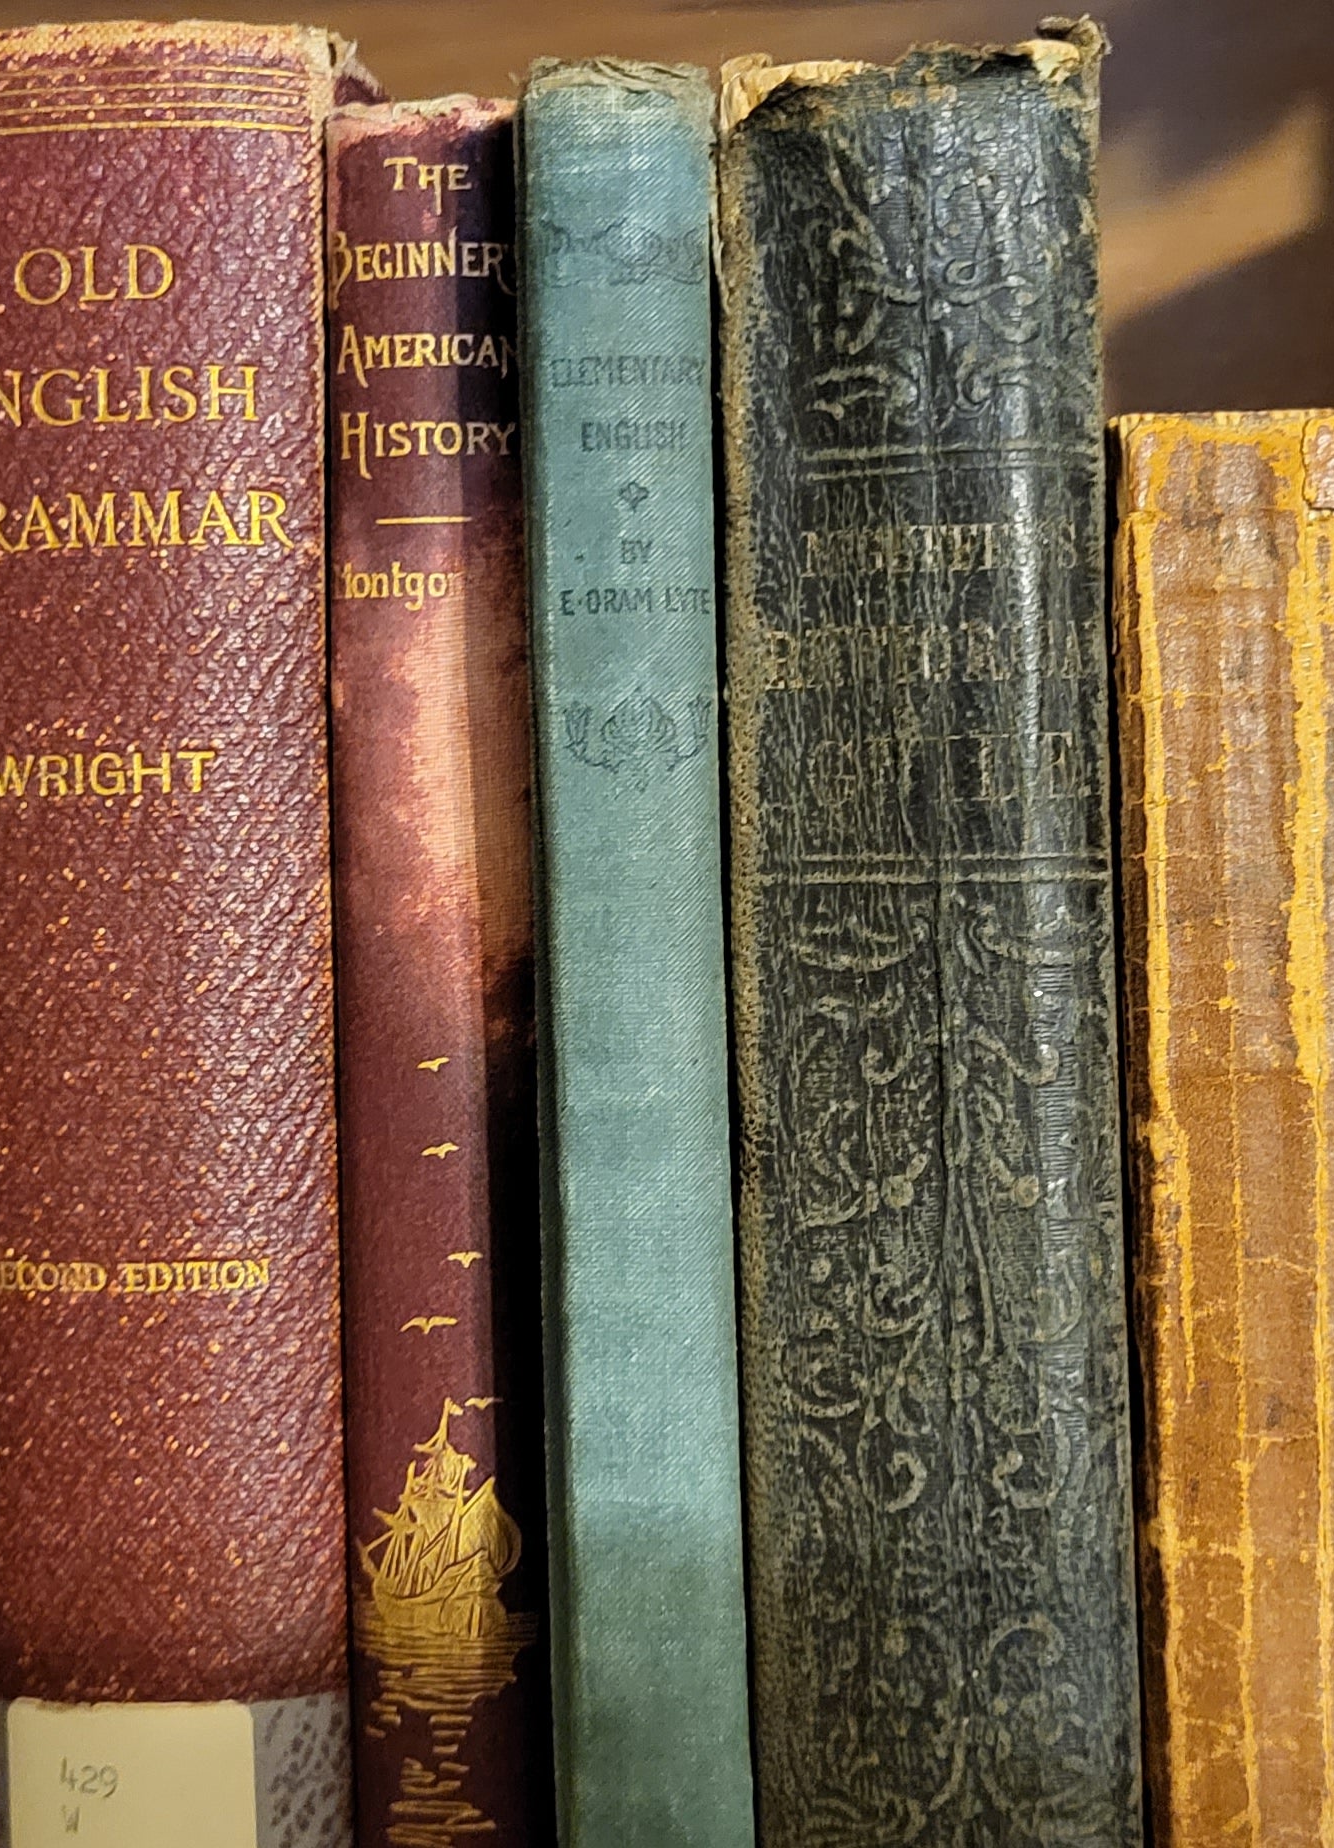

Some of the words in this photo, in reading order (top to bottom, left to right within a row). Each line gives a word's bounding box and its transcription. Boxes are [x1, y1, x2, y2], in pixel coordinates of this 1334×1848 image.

[384, 156, 472, 215] THE
[13, 243, 174, 306] OLD
[330, 226, 517, 310] BEGINNER
[337, 324, 519, 389] AMERICAN
[551, 354, 706, 388] ELEMENTARY
[341, 411, 516, 480] HISTORY
[581, 420, 686, 452] ENGLISH
[619, 539, 653, 565] BY
[665, 587, 711, 616] LYTE
[119, 1257, 271, 1294] EDITION
[58, 1756, 119, 1800] 429
